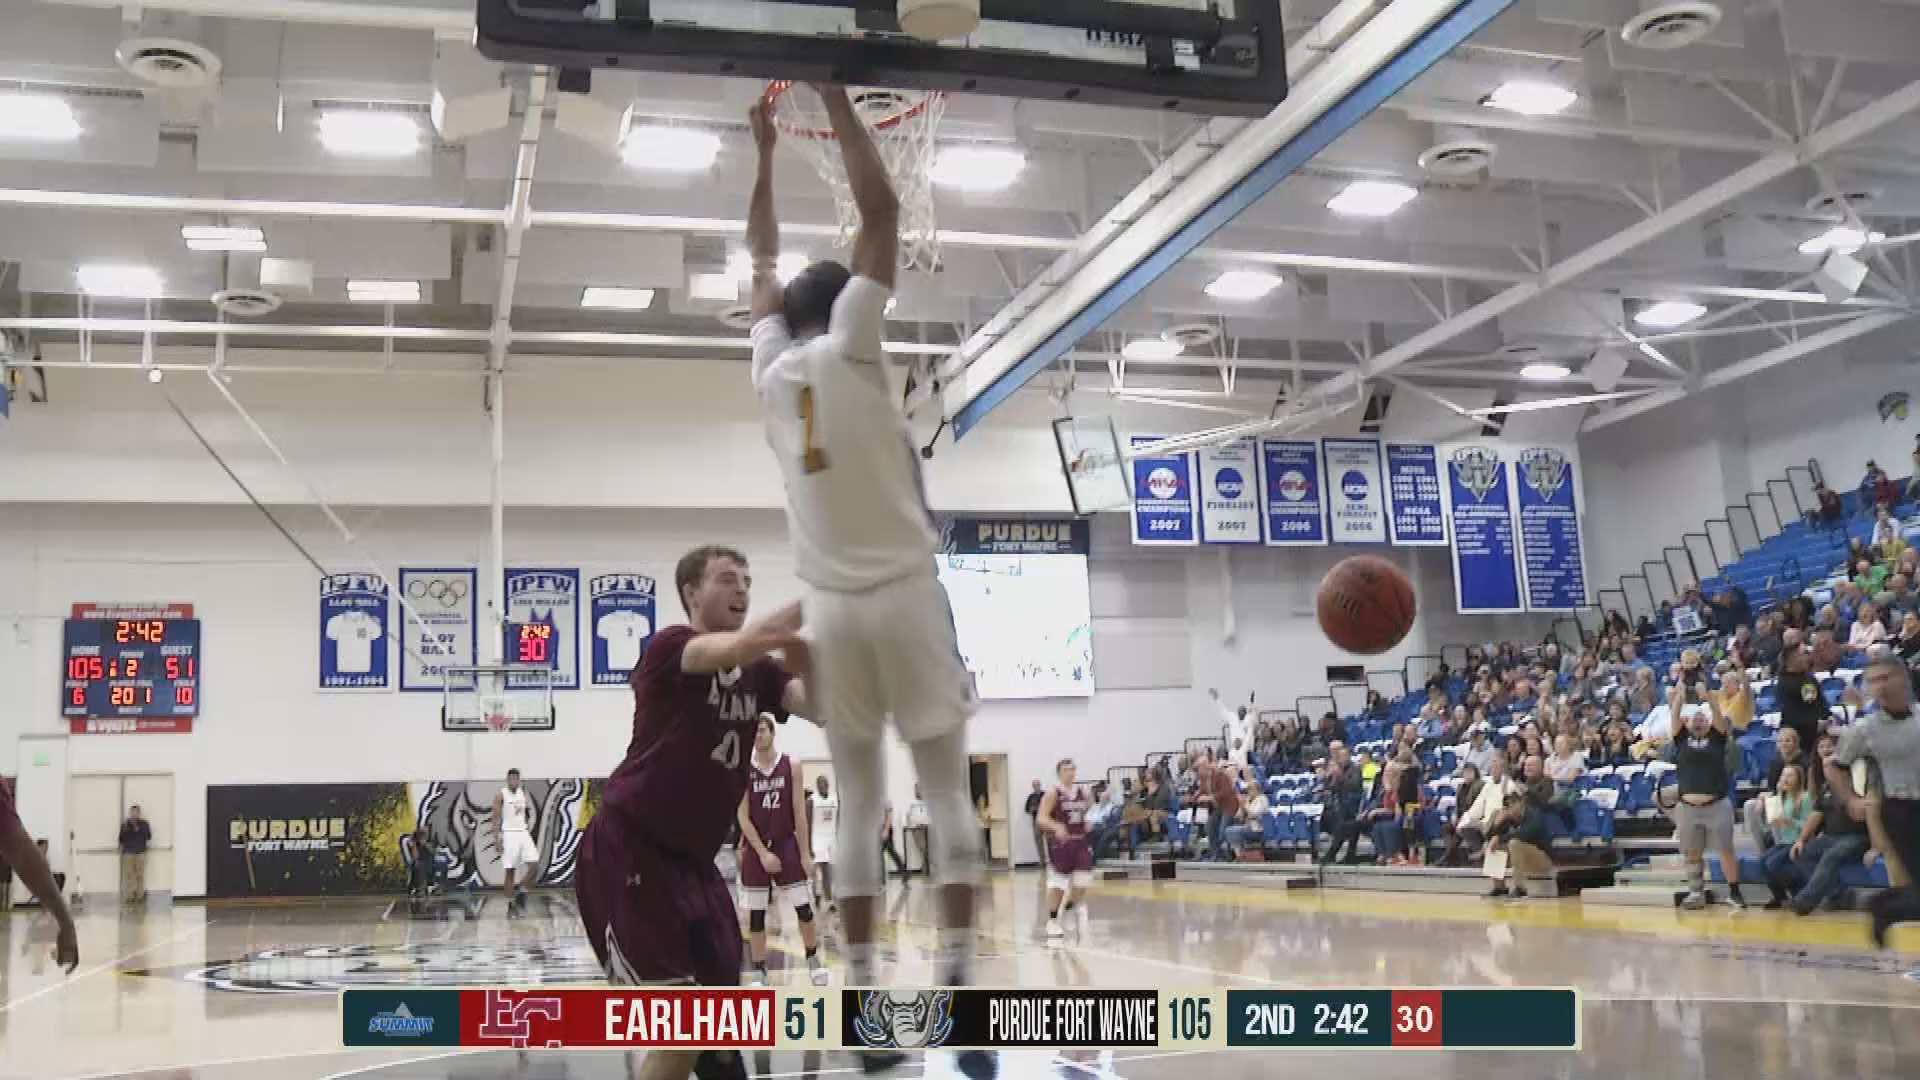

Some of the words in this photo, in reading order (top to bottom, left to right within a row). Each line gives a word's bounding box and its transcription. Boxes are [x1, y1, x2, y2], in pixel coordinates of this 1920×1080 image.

[978, 523, 1072, 542] PURDUE
[508, 576, 572, 595] IPFW
[590, 574, 656, 598] IPFW
[116, 620, 163, 643] 2:42
[519, 639, 545, 661] 30
[68, 656, 103, 679] 105
[73, 687, 85, 705] 6
[175, 687, 193, 705] 10
[762, 792, 781, 809] 42
[230, 818, 346, 841] PURDUE
[246, 841, 280, 851] FORT
[283, 840, 329, 850] WAYNE
